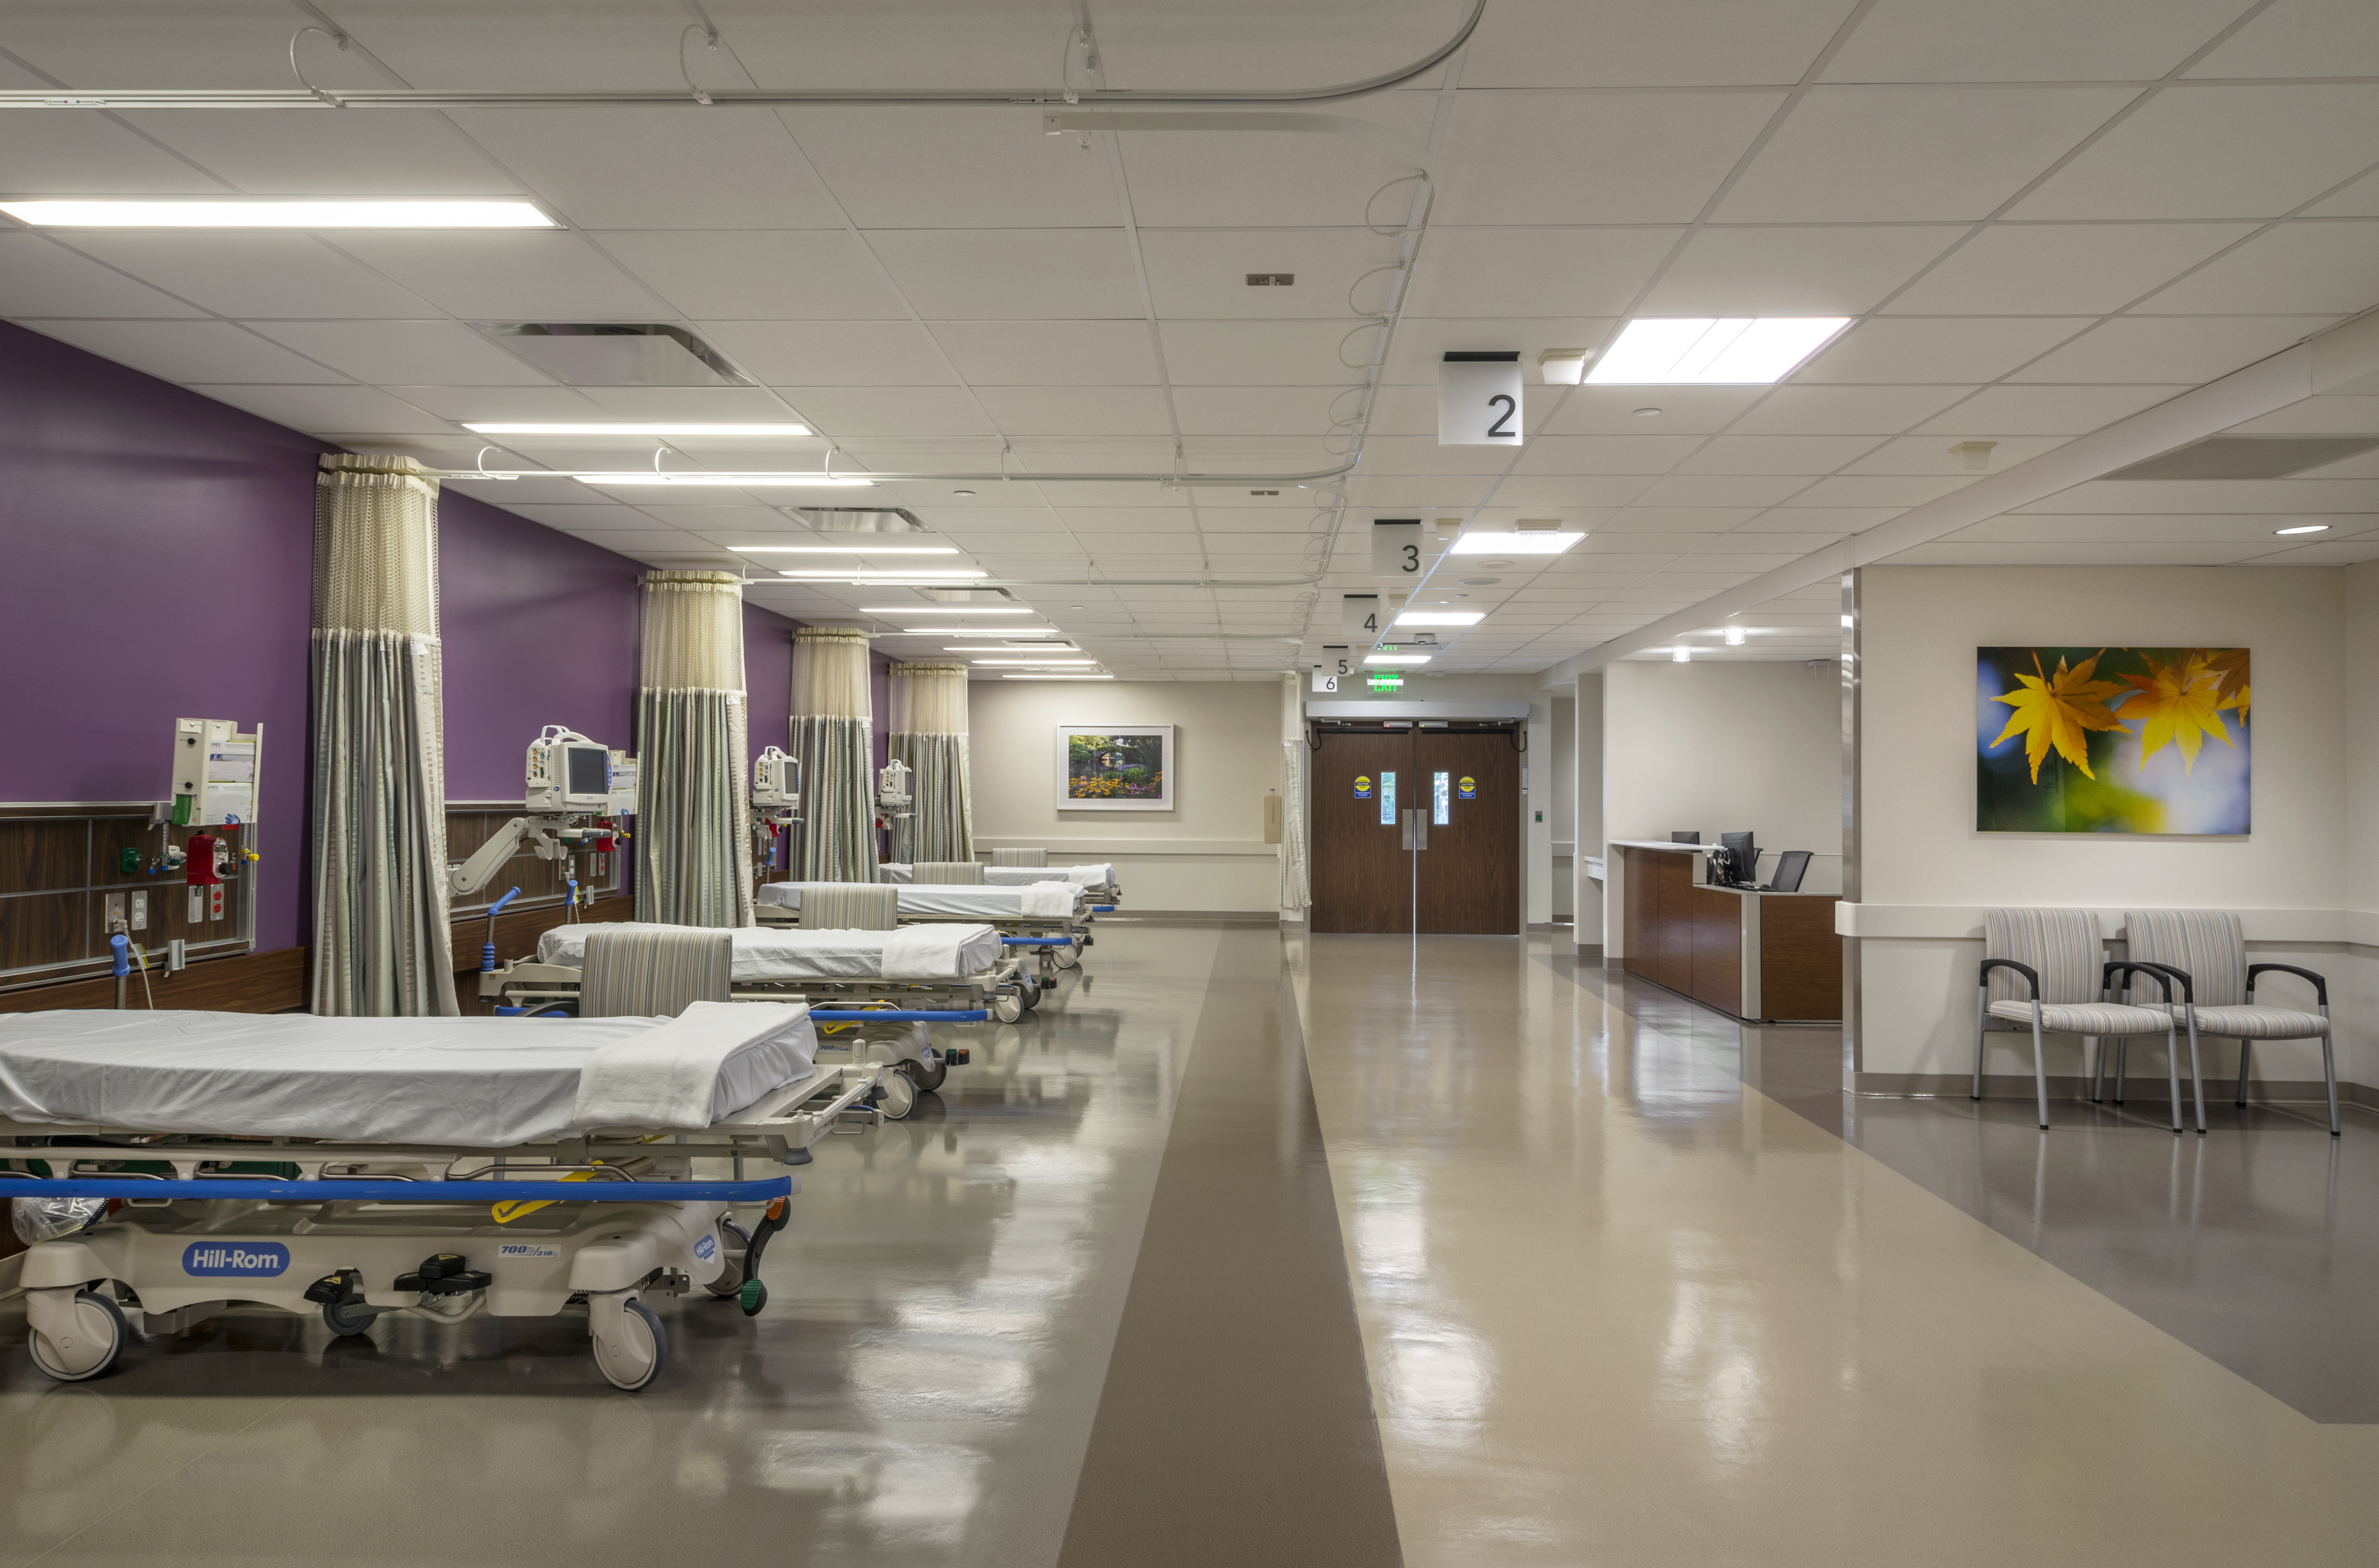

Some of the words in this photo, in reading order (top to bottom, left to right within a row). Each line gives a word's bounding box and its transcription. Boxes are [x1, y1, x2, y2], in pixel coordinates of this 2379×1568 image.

[1488, 394, 1516, 437] 2
[1401, 544, 1420, 572] 3
[1364, 613, 1378, 633] 4
[1338, 659, 1348, 674] 5
[1326, 677, 1335, 690] 6
[1374, 675, 1398, 691] EXIT
[695, 1239, 714, 1256] Hill-Rom
[193, 1249, 278, 1269] Hill-Rom
